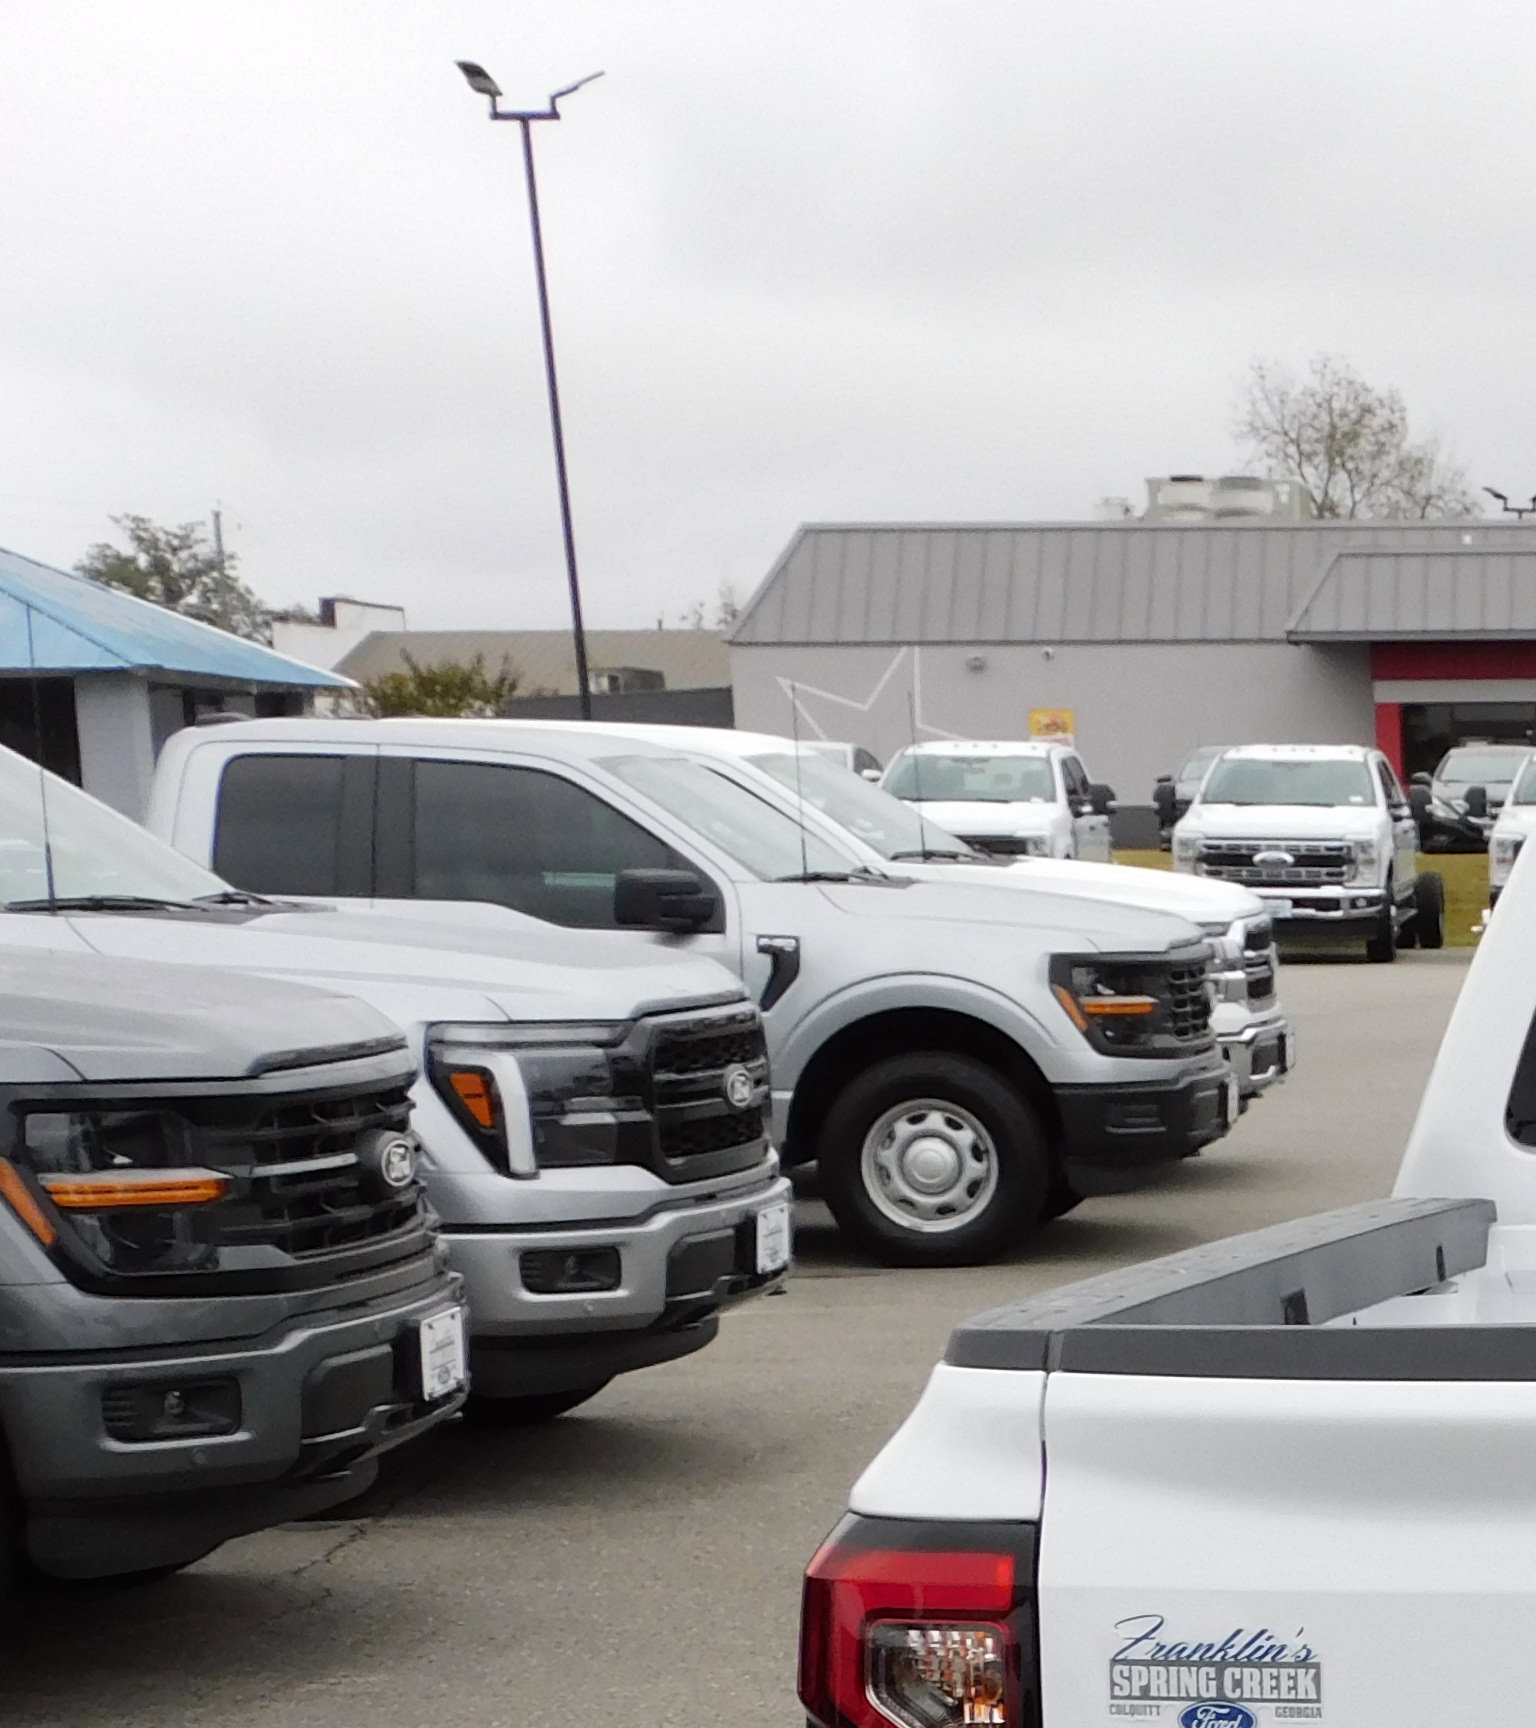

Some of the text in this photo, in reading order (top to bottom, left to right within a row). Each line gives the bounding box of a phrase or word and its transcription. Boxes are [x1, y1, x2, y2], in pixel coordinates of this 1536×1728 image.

[1113, 1614, 1318, 1663] Franklin's
[1112, 1664, 1318, 1700] SPRING CREEK
[1274, 1706, 1322, 1719] GEORGIA
